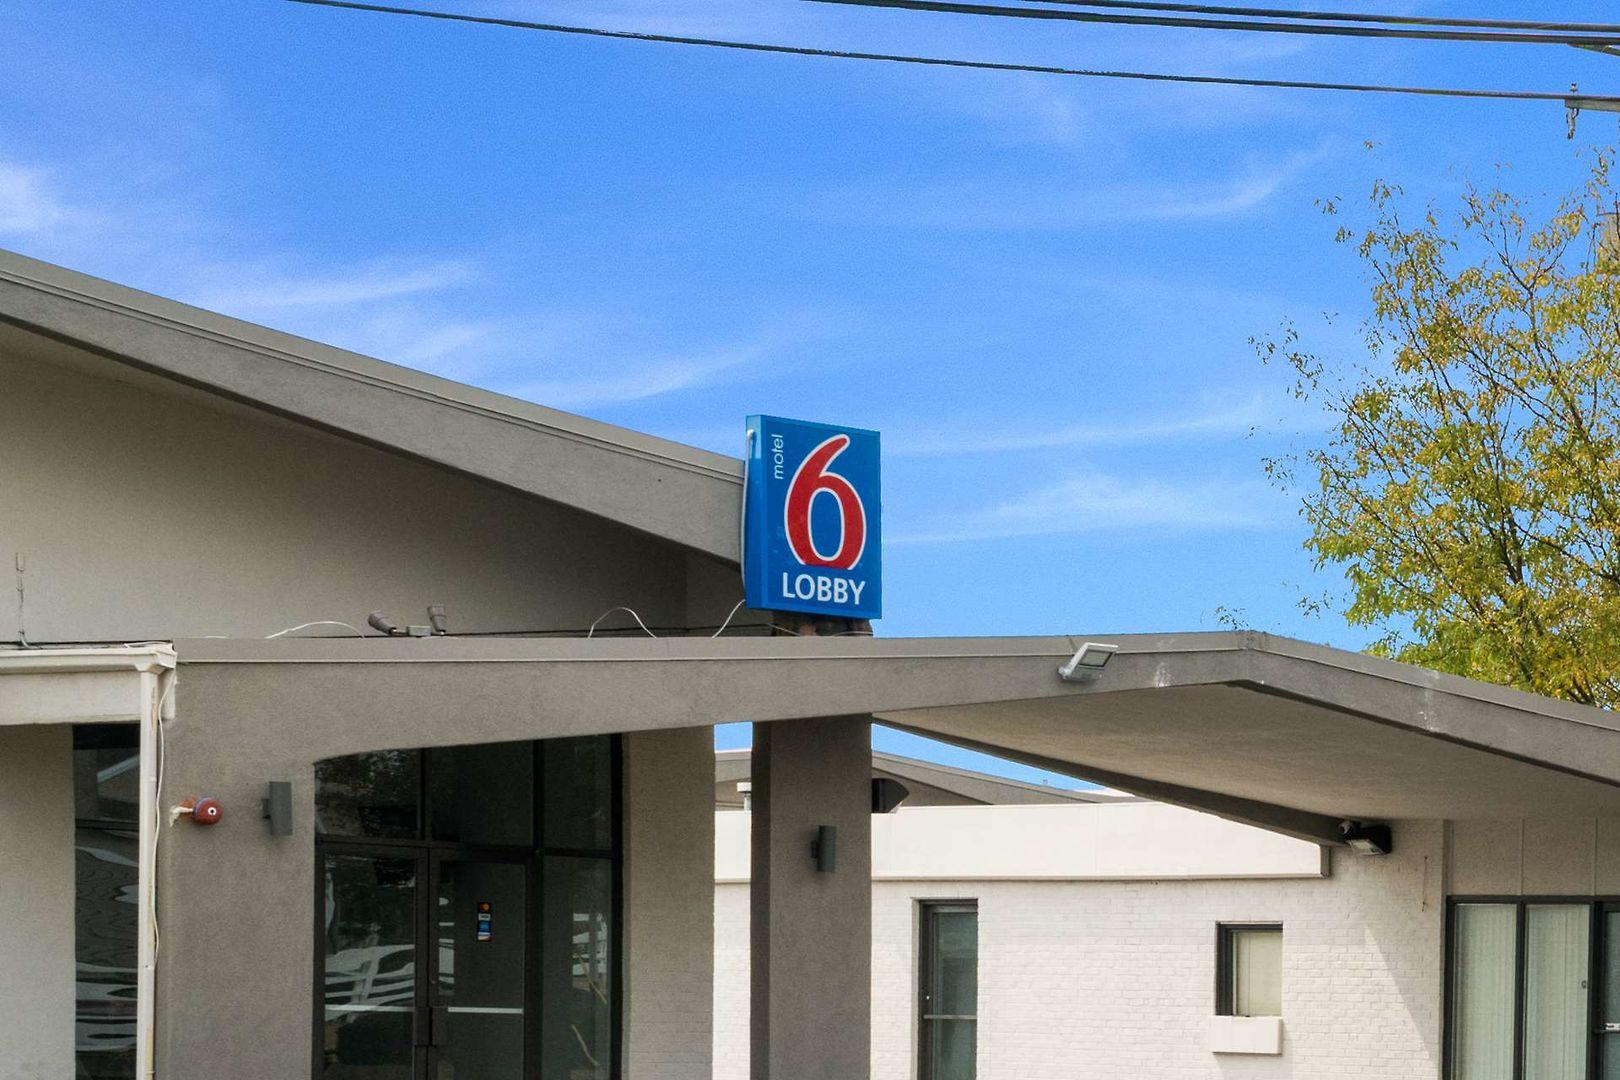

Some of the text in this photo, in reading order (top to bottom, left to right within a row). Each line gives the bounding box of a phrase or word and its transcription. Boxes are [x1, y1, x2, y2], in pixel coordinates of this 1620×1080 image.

[771, 433, 867, 571] motel 6
[783, 572, 866, 605] LOBBY
